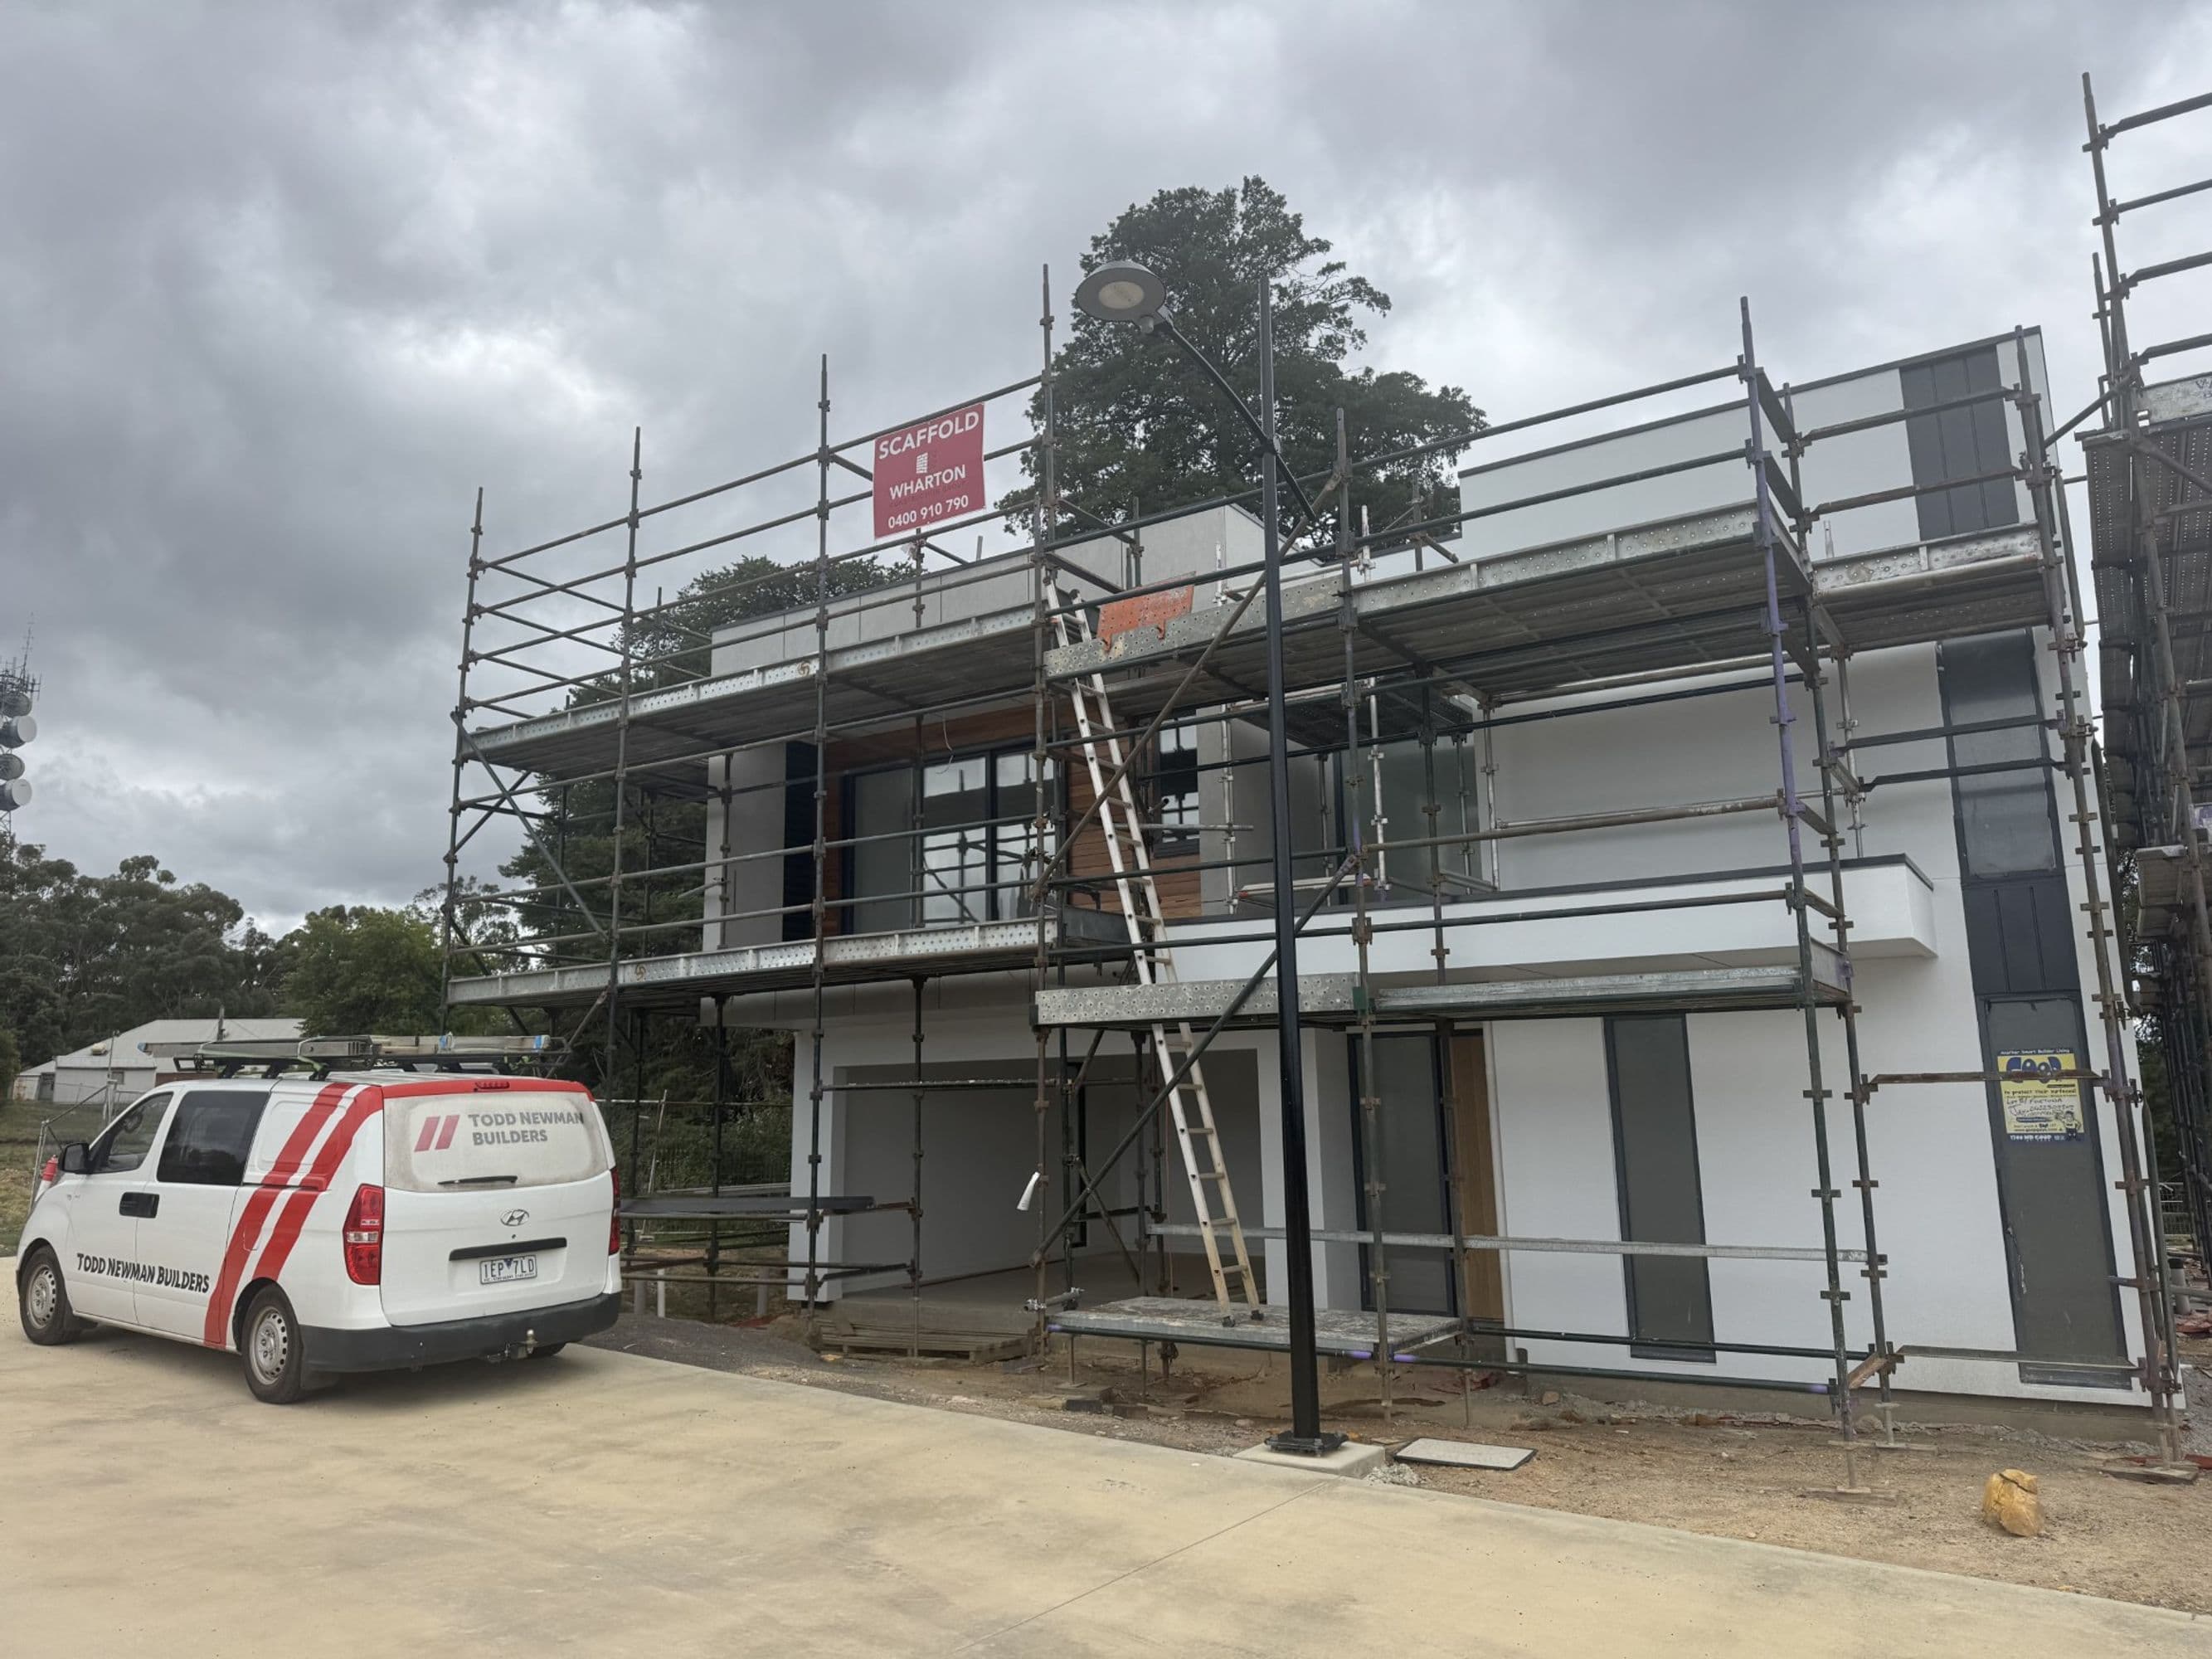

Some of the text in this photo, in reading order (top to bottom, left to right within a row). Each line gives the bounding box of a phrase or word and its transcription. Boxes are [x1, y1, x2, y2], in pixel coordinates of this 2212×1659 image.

[878, 411, 980, 460] SCAFFOLD
[889, 464, 966, 500] WHARTON
[887, 510, 917, 529] 0400
[920, 503, 943, 520] 910
[946, 494, 969, 513] 790
[468, 1112, 586, 1127] TODD NEWMAN
[472, 1129, 548, 1146] BUILDERS
[76, 1253, 210, 1293] TODD NEWMAN BUILDERS
